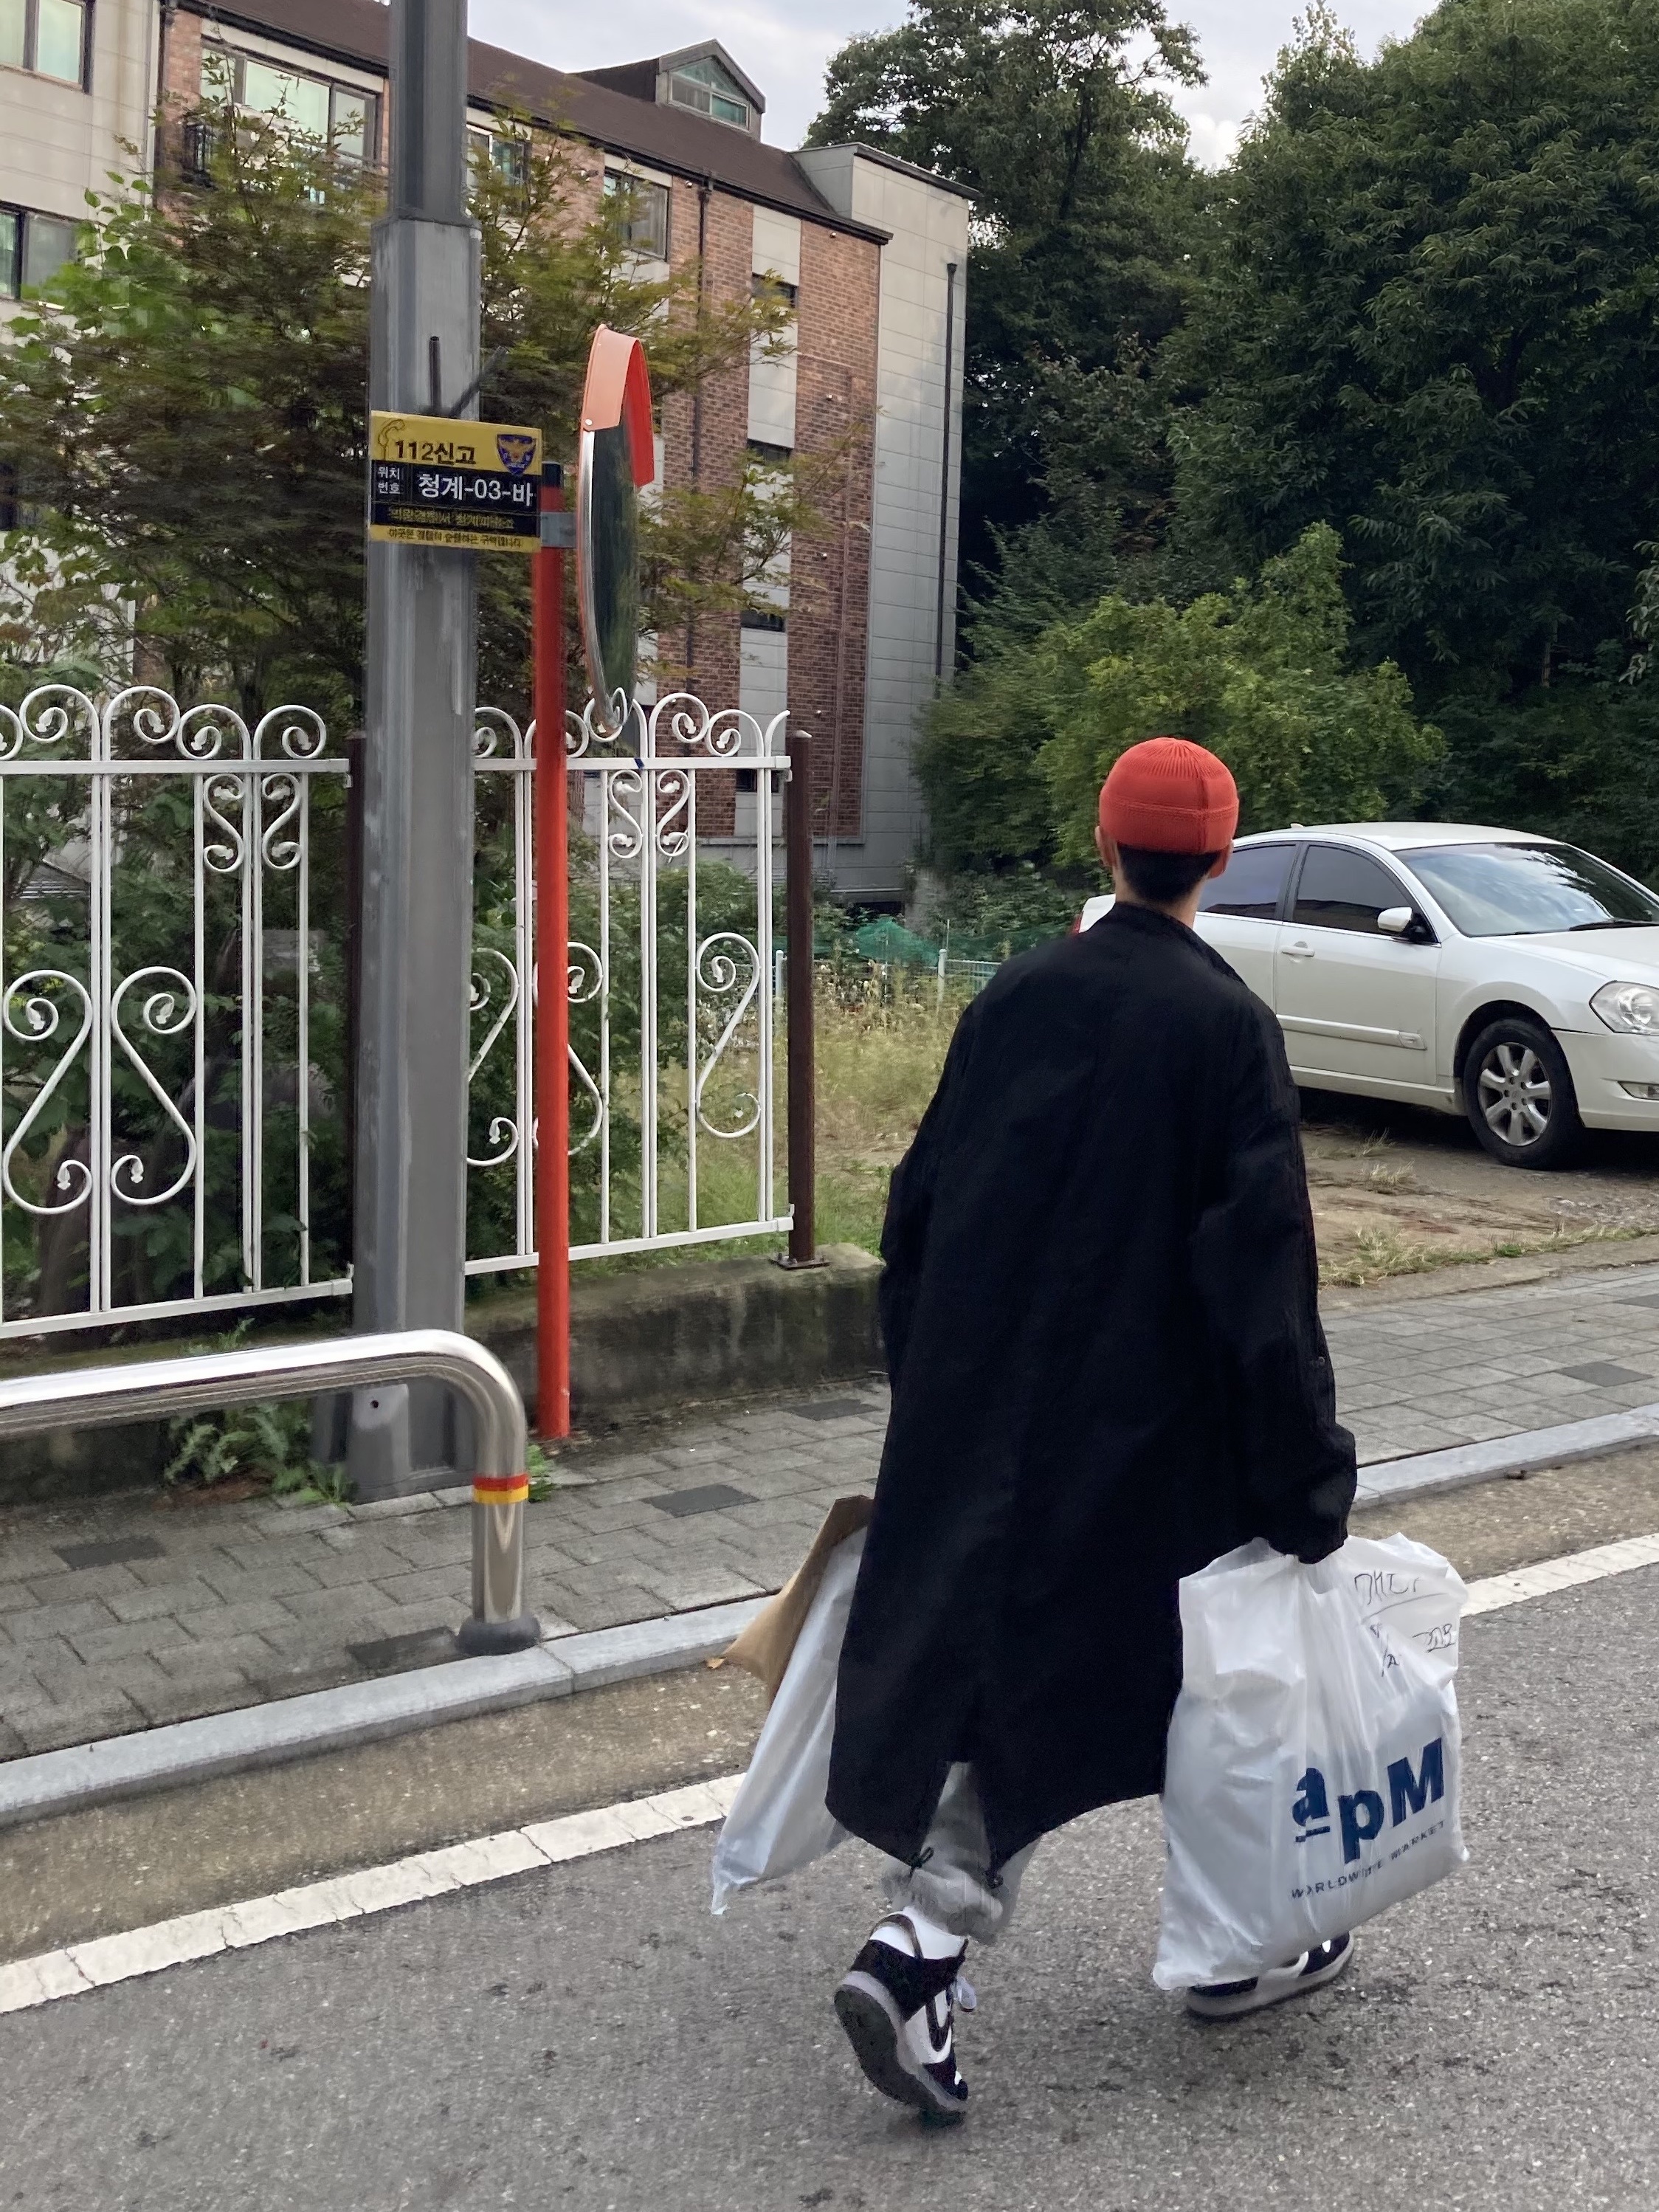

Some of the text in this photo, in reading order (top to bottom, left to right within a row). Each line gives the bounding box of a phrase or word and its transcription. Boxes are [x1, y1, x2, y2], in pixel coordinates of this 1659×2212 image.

[396, 440, 476, 465] 112신고
[377, 466, 400, 480] 위치
[377, 482, 400, 495] 번호
[418, 473, 534, 506] 청계-03-바
[1292, 1737, 1444, 1864] apM
